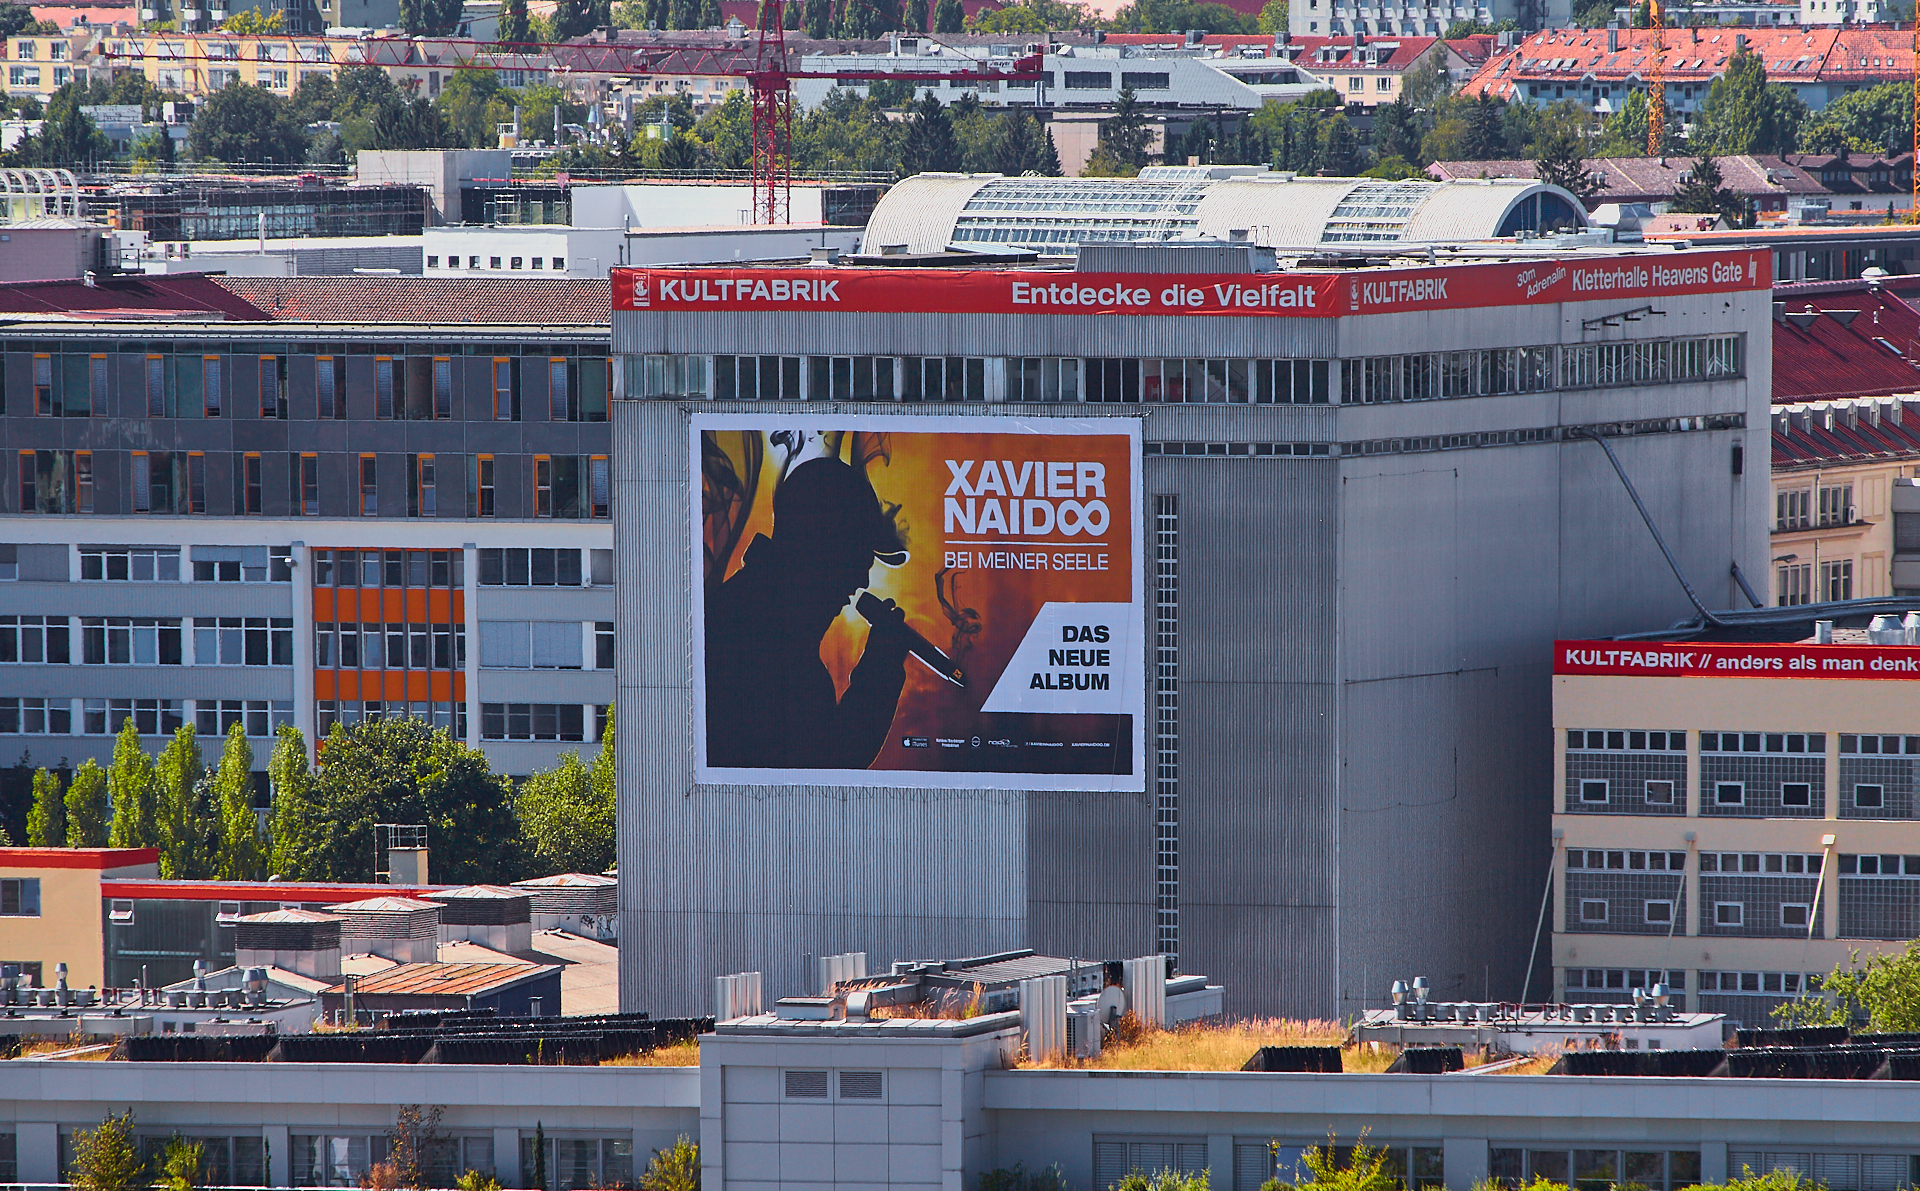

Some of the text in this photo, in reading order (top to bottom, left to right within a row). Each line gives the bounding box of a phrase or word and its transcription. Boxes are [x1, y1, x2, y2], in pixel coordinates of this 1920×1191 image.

[1517, 268, 1536, 288] 30m
[1526, 266, 1567, 299] Adrenalin
[1572, 260, 1742, 291] Kletterhalle Heavens Gate
[659, 279, 840, 302] KULTFABRIK
[1011, 281, 1316, 308] Entdecke die Vielfalt
[1363, 278, 1448, 304] KULTFABRIK
[944, 460, 1106, 498] XAVIER
[944, 551, 1109, 571] BEI MEINER SEELE
[1062, 625, 1110, 643] DAS
[1048, 649, 1110, 667] NEUE
[1565, 649, 1694, 668] KULTFABRIK
[1788, 654, 1817, 670] als
[1822, 658, 1865, 671] man
[1869, 656, 1920, 671] denk
[1029, 672, 1110, 691] ALBUM
